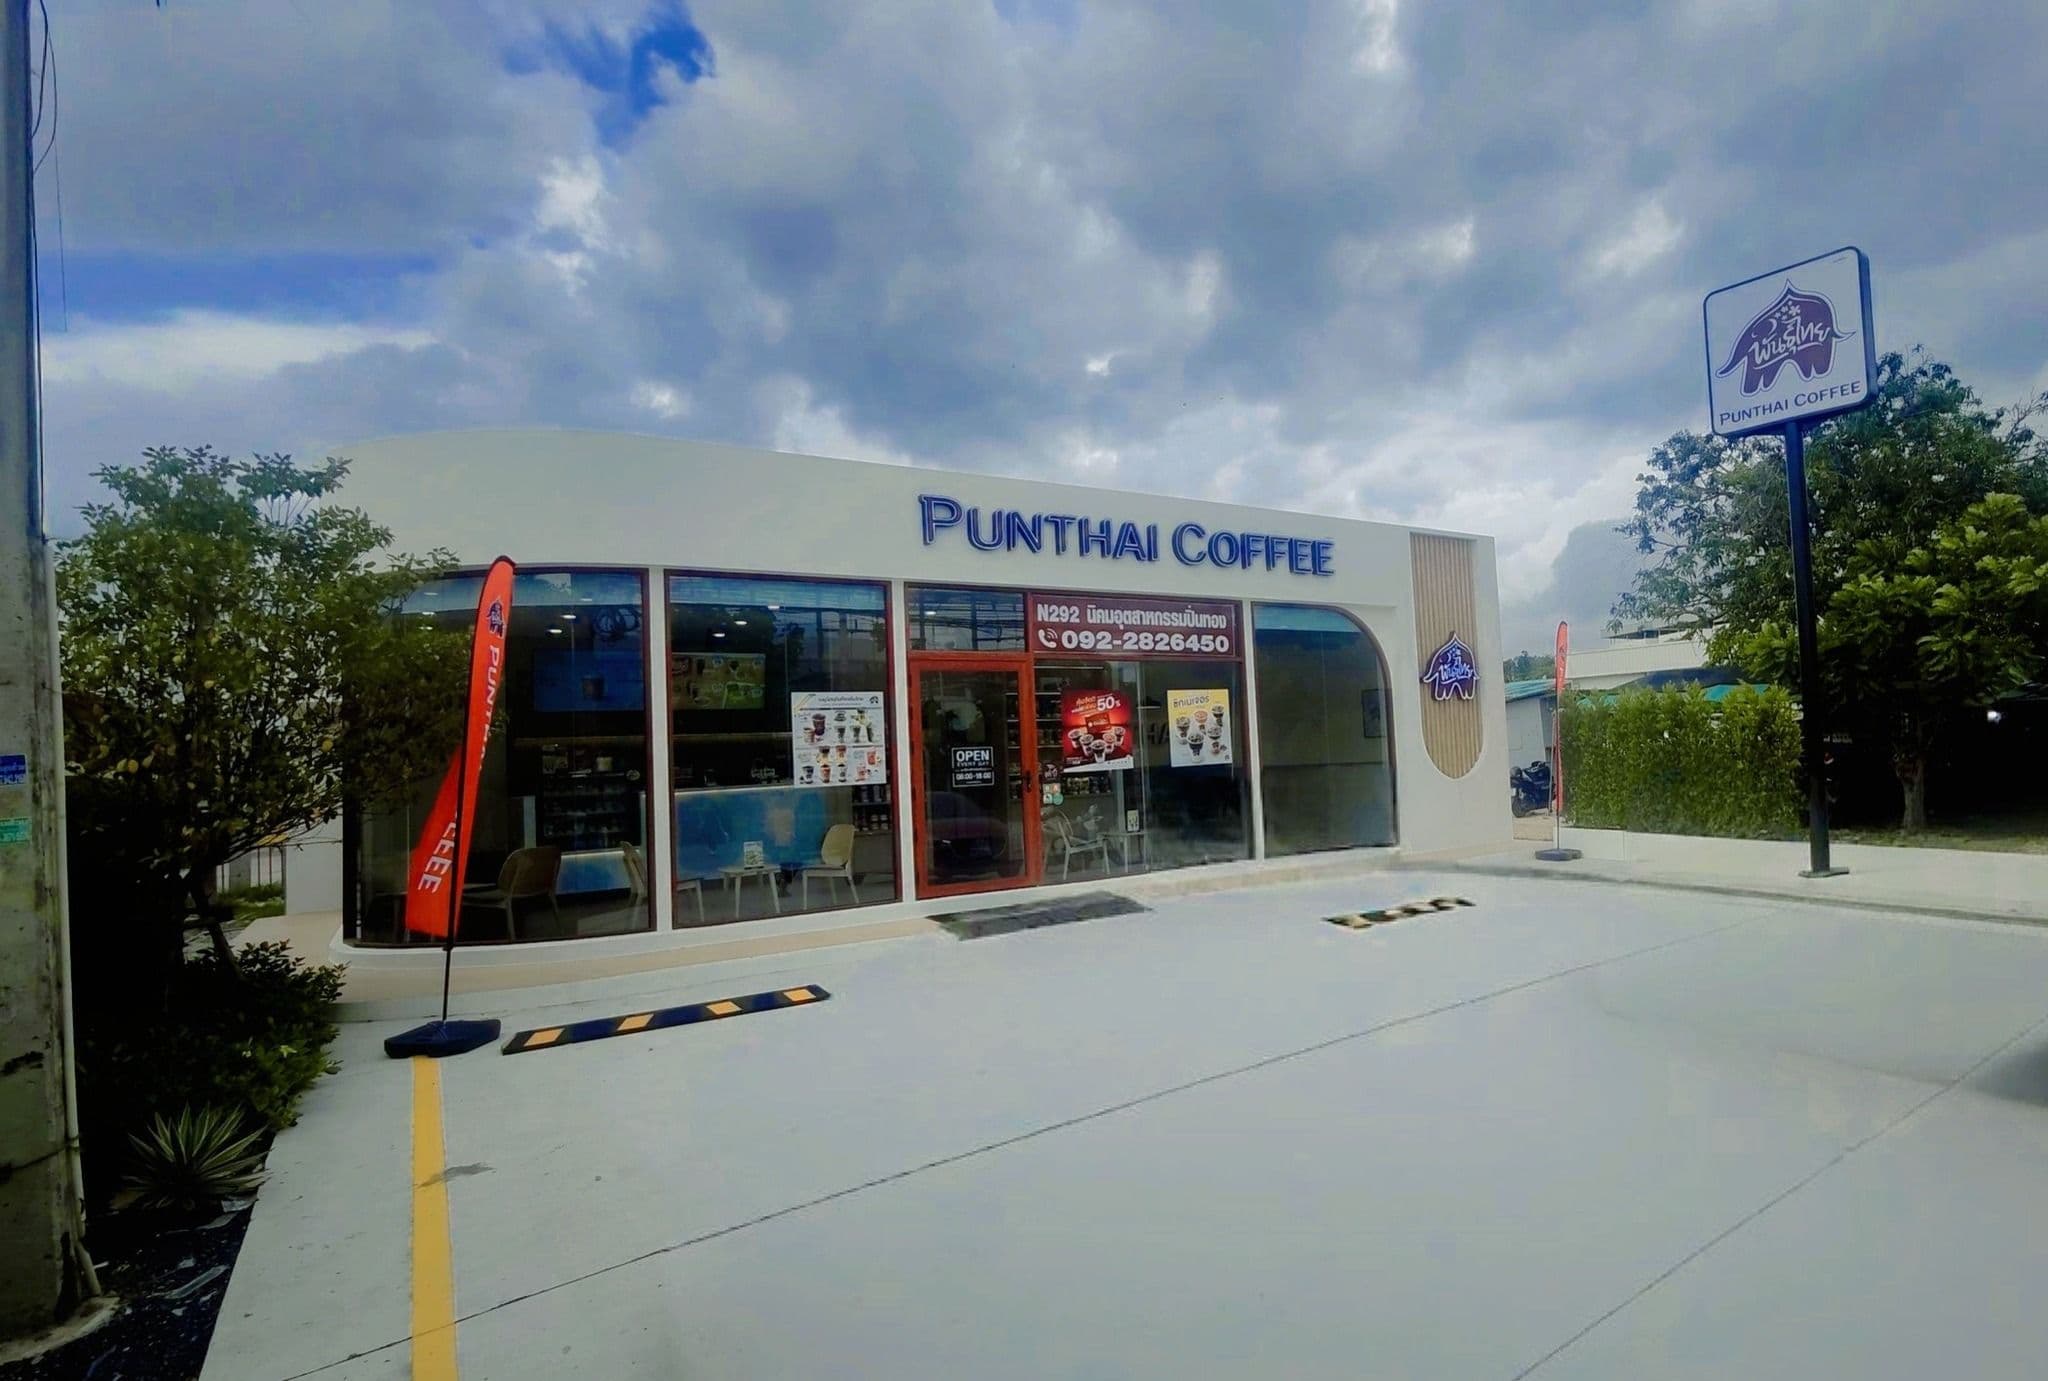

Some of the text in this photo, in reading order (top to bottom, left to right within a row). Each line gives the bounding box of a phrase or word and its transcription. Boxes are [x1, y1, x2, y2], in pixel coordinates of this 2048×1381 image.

[1719, 381, 1861, 426] PUNTHAI COFFEE
[918, 493, 1336, 576] PUNTHAI COFFEE
[1037, 604, 1227, 630] N292 นิคมอุตสาหกรรมปิ่นทอง
[1061, 630, 1230, 653] 092-2826450
[956, 749, 990, 762] OPEN
